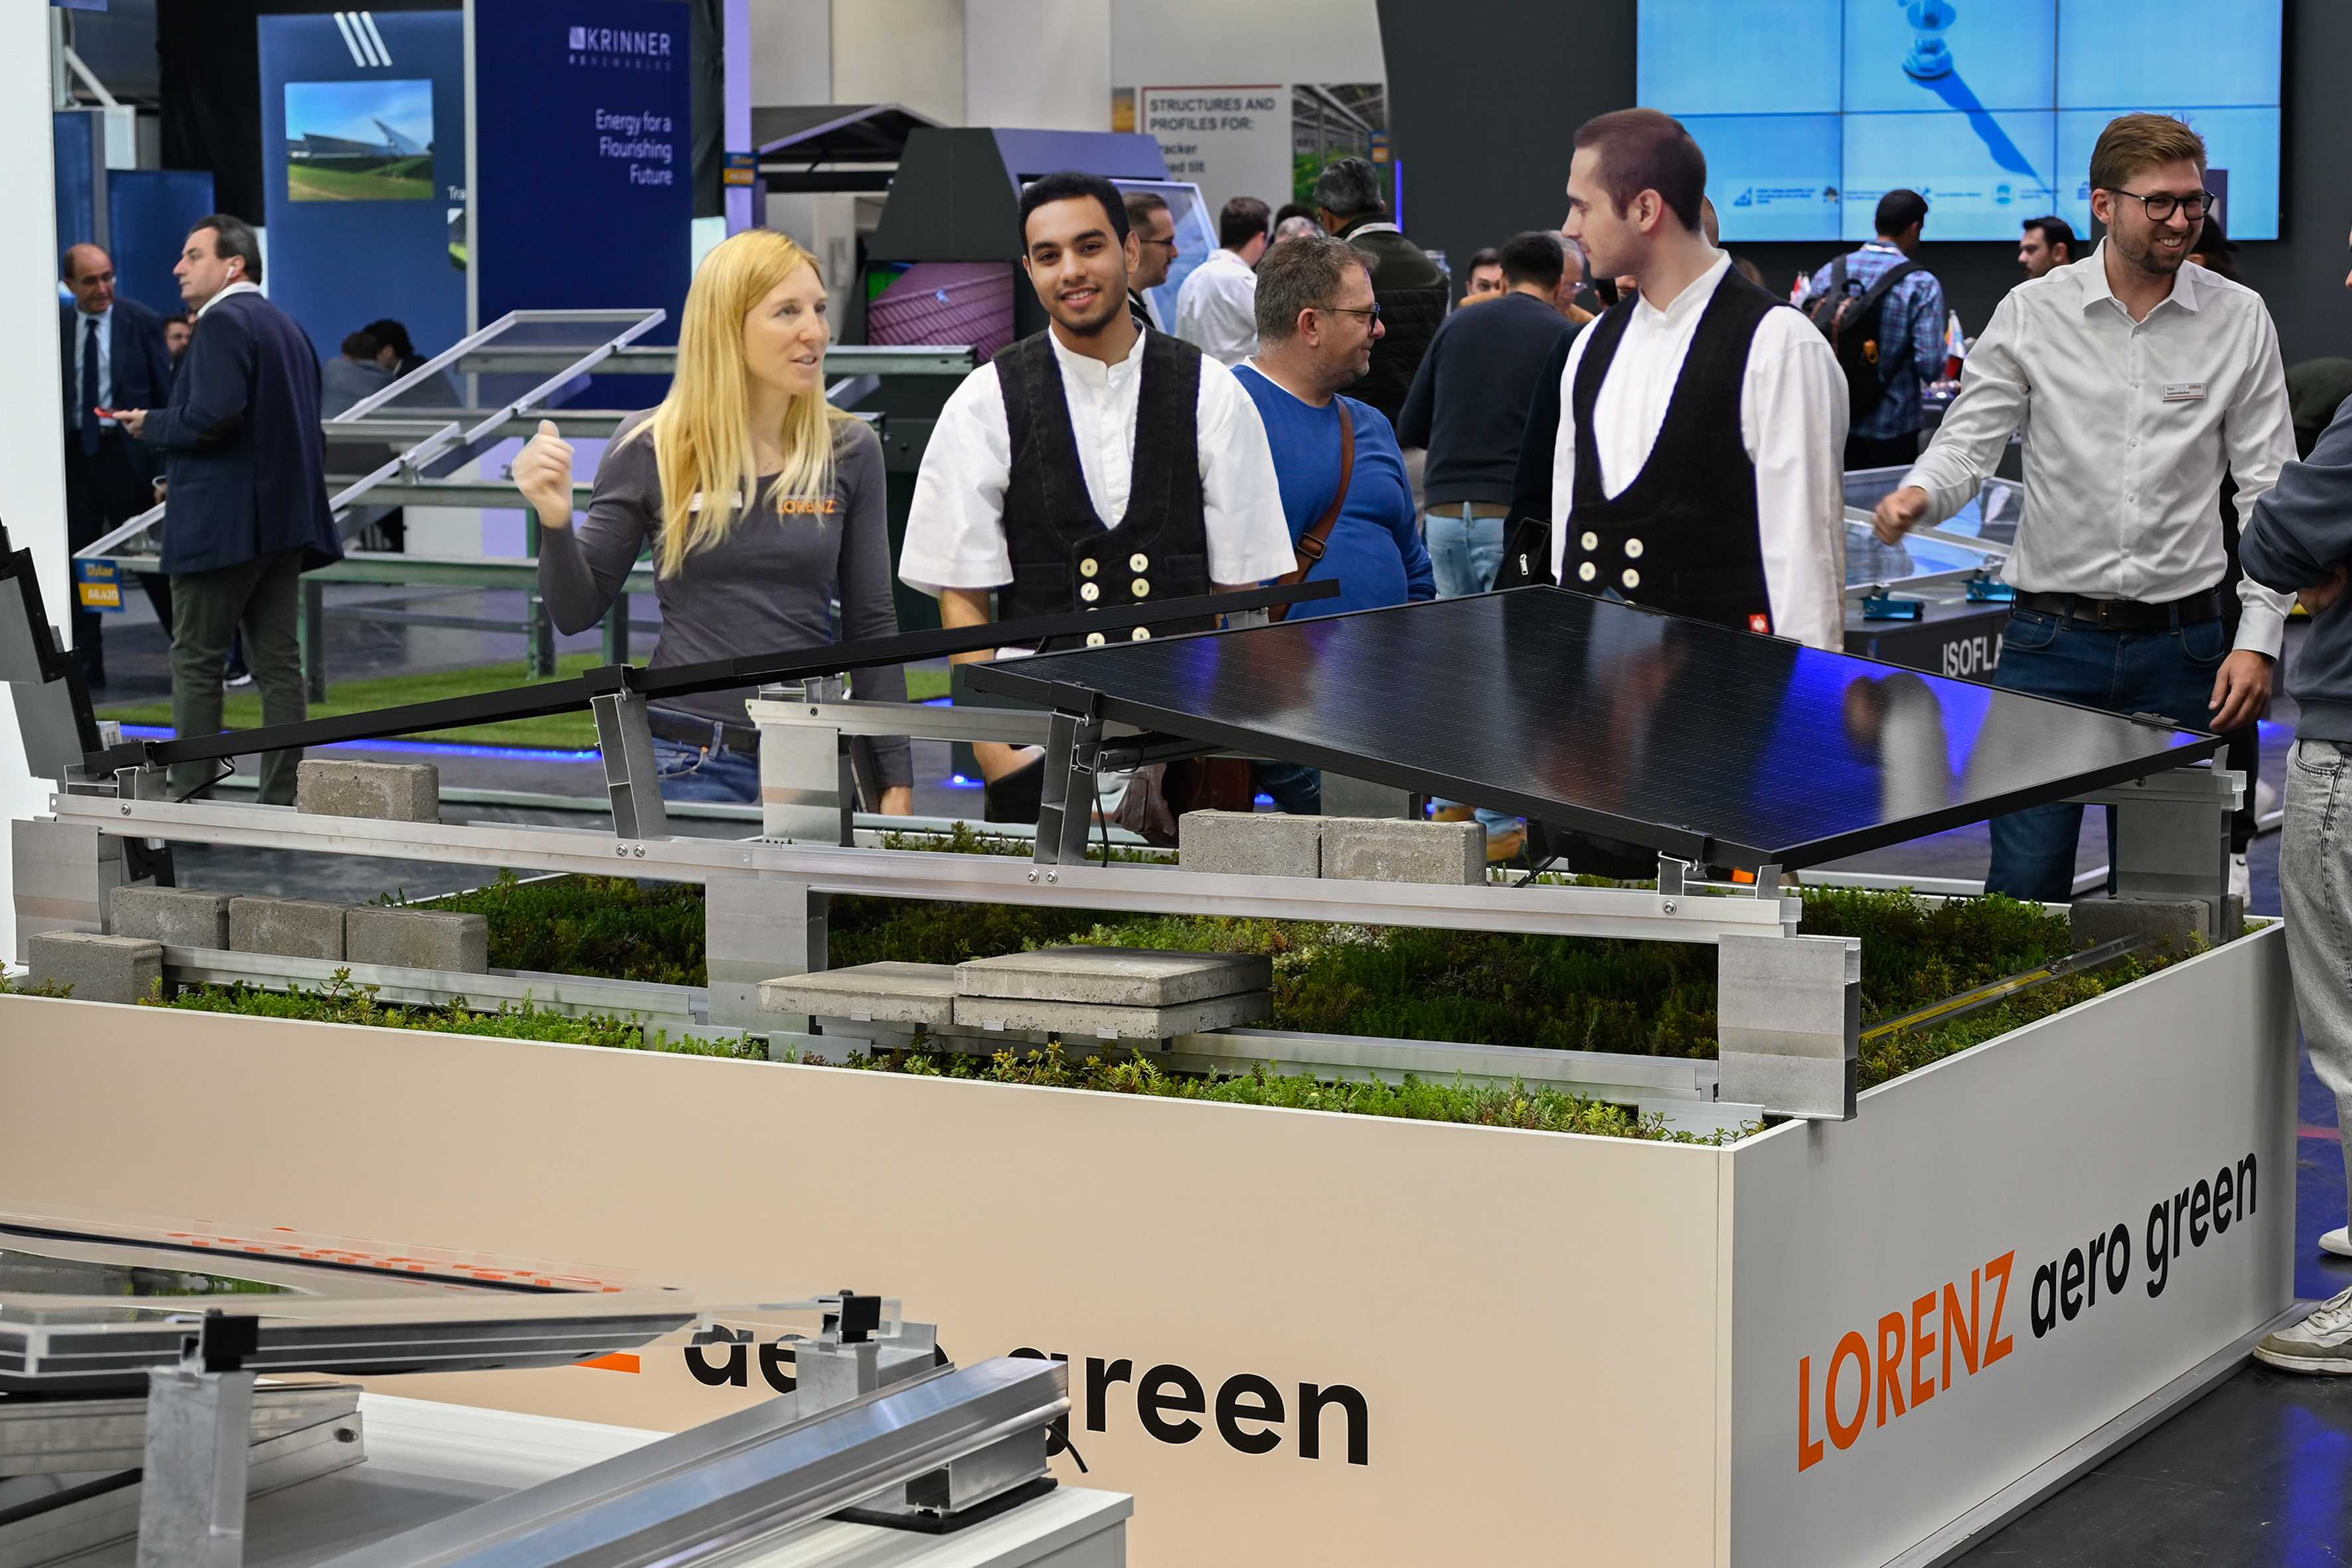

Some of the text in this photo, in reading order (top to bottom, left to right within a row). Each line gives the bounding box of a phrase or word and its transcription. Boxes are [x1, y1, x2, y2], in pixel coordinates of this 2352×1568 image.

[587, 27, 671, 56] KRINNER
[1149, 98, 1275, 112] STRUCTURES AND
[595, 108, 672, 136] Energy for a
[1149, 116, 1254, 131] PROFILES FOR:
[599, 135, 673, 165] Flourishing
[630, 163, 674, 185] Future
[1798, 1152, 2257, 1473] LORENZ aero green
